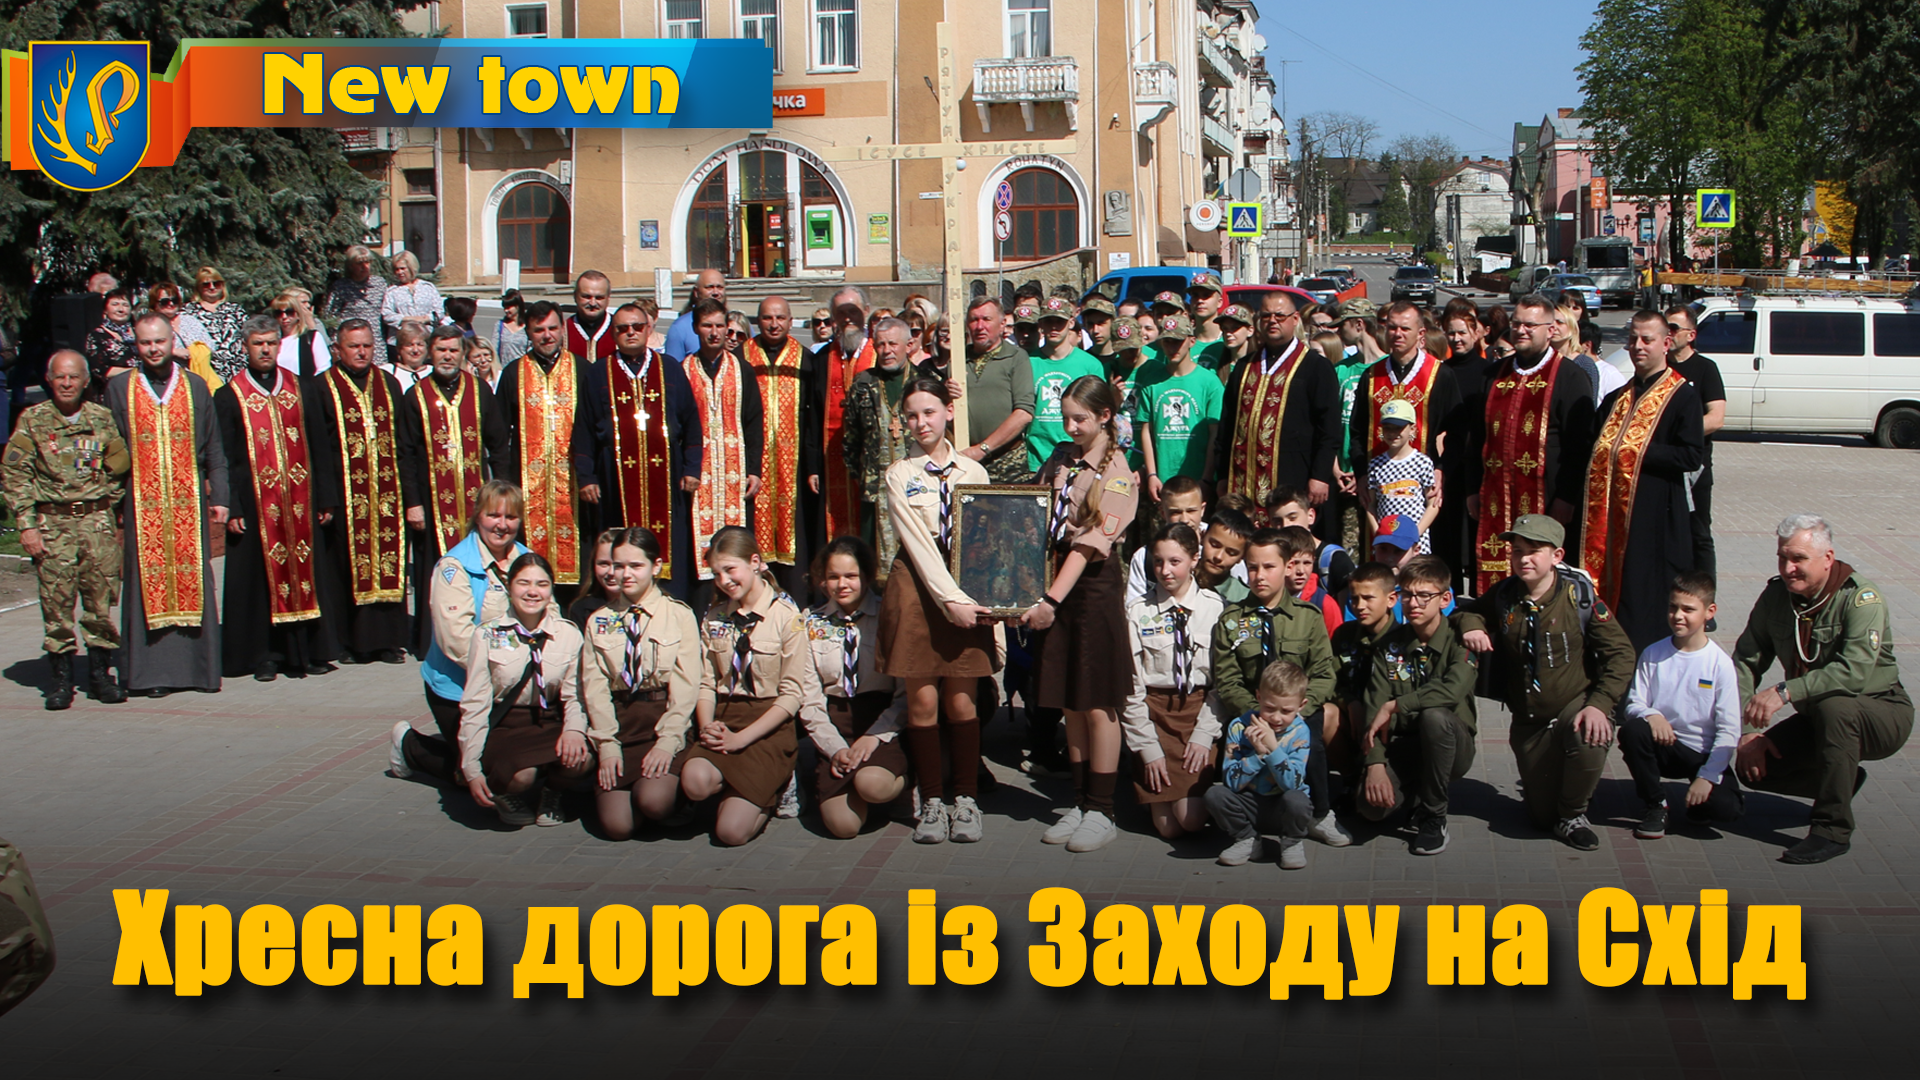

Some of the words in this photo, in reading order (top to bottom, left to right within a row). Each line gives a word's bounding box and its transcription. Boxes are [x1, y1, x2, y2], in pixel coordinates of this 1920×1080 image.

[963, 142, 1046, 156] ХРИСТЕ
[692, 151, 729, 184] DOM
[736, 139, 831, 174] HANDLOWY
[1005, 154, 1066, 172] ROHATYN
